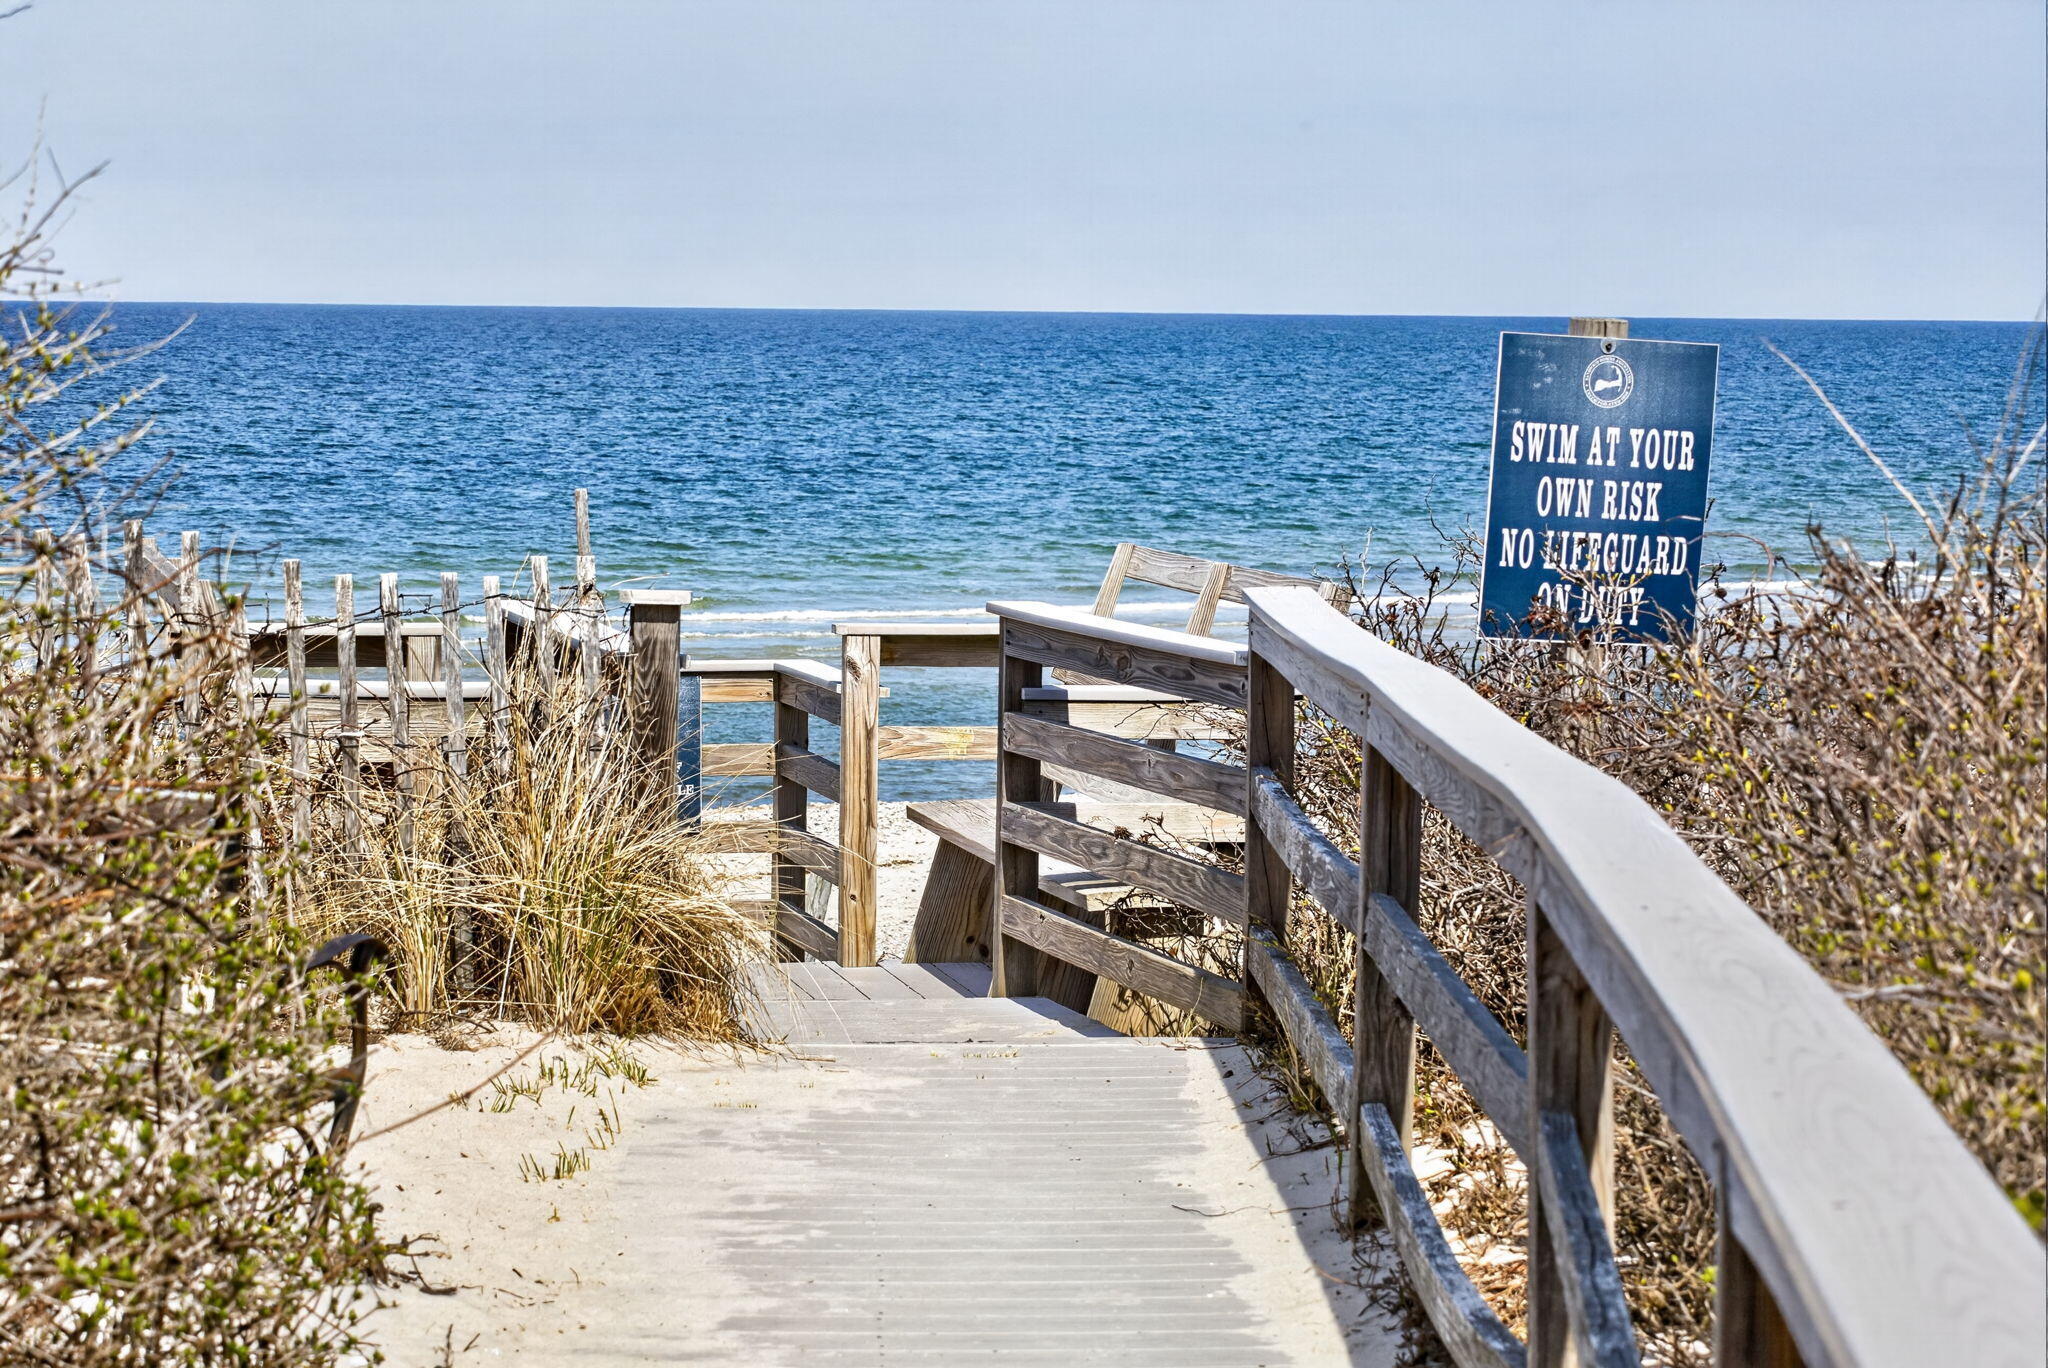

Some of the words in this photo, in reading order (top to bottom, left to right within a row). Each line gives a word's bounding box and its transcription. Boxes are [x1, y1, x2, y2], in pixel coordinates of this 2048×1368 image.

[1510, 420, 1579, 465] SWIM
[1587, 426, 1621, 467] AT
[1630, 428, 1695, 471] YOUR
[1537, 476, 1594, 518] OWN
[1601, 480, 1663, 522] RISK
[1499, 528, 1534, 569] NO
[1543, 530, 1688, 576] LIFEGUARD
[1578, 585, 1645, 626] DUTY
